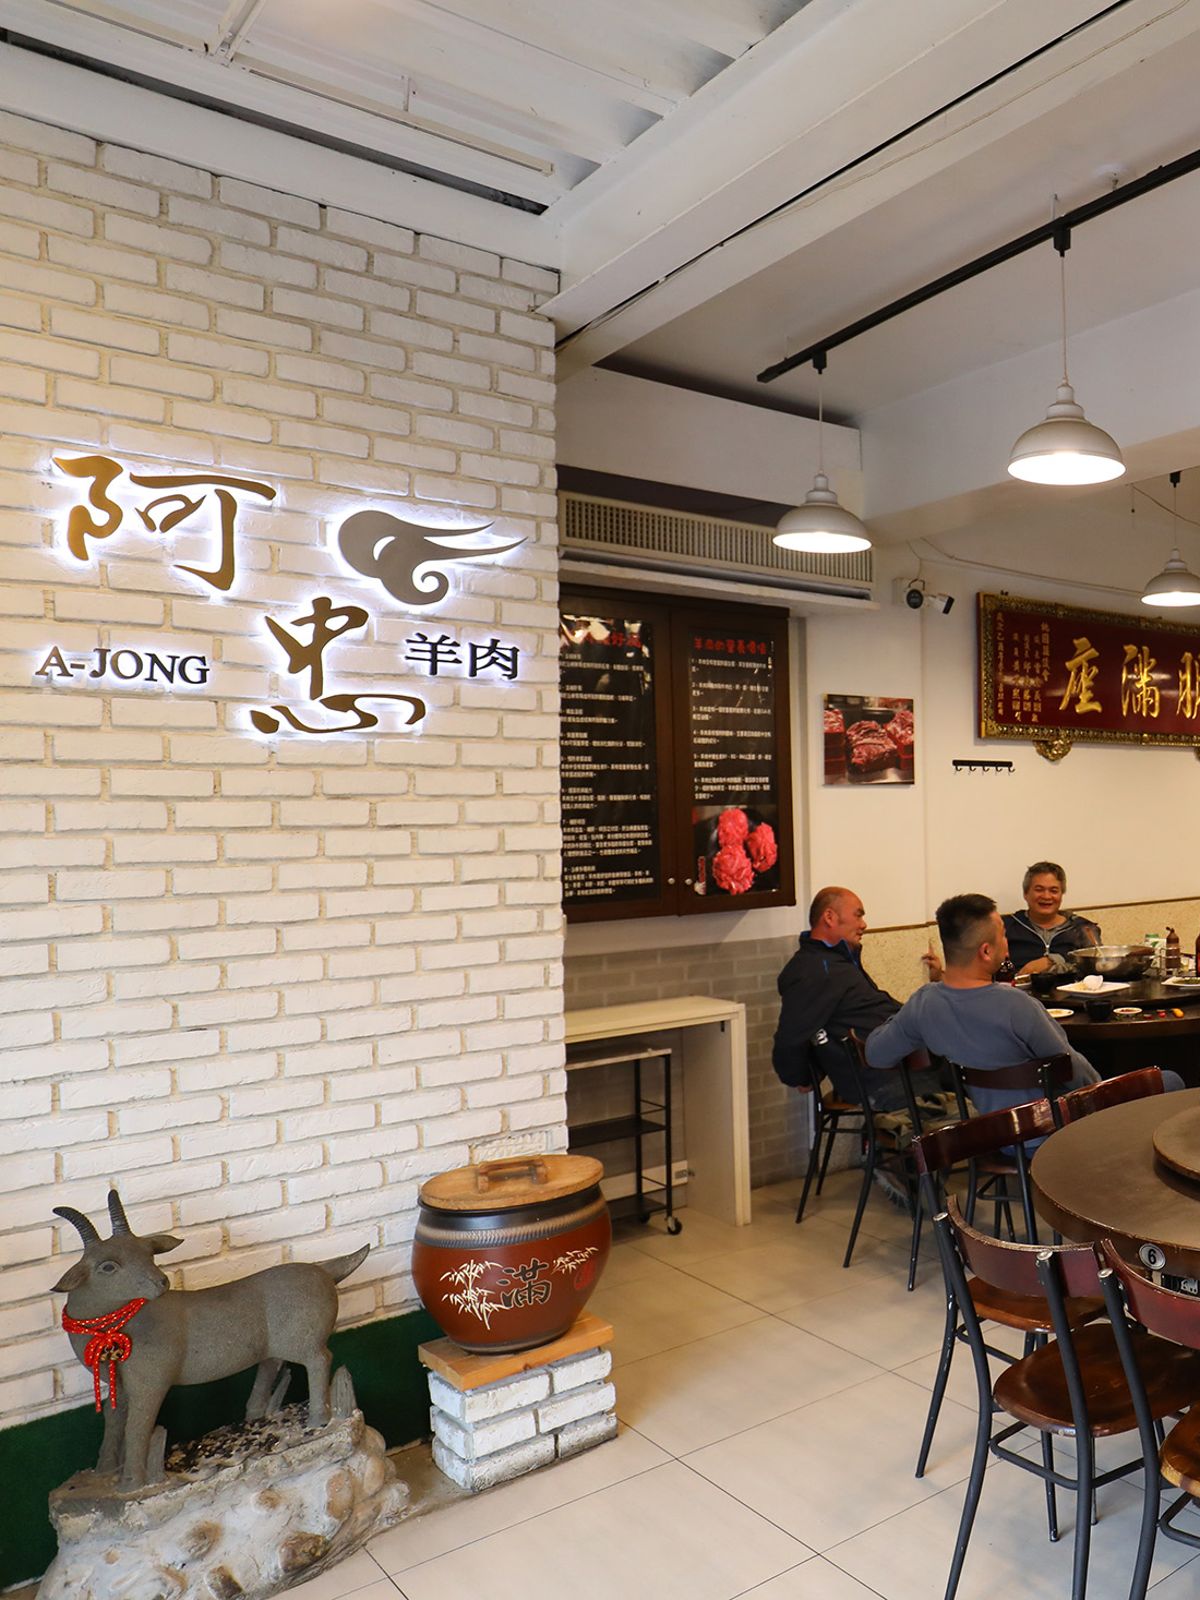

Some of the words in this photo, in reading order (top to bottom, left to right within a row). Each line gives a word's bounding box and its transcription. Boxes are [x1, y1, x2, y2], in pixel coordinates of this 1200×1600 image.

[52, 455, 276, 591] 阿
[251, 596, 426, 734] 忠
[36, 645, 210, 685] A-JONG
[404, 633, 520, 680] 羊肉
[1148, 1249, 1156, 1264] 6
[497, 1259, 552, 1308] 滿
